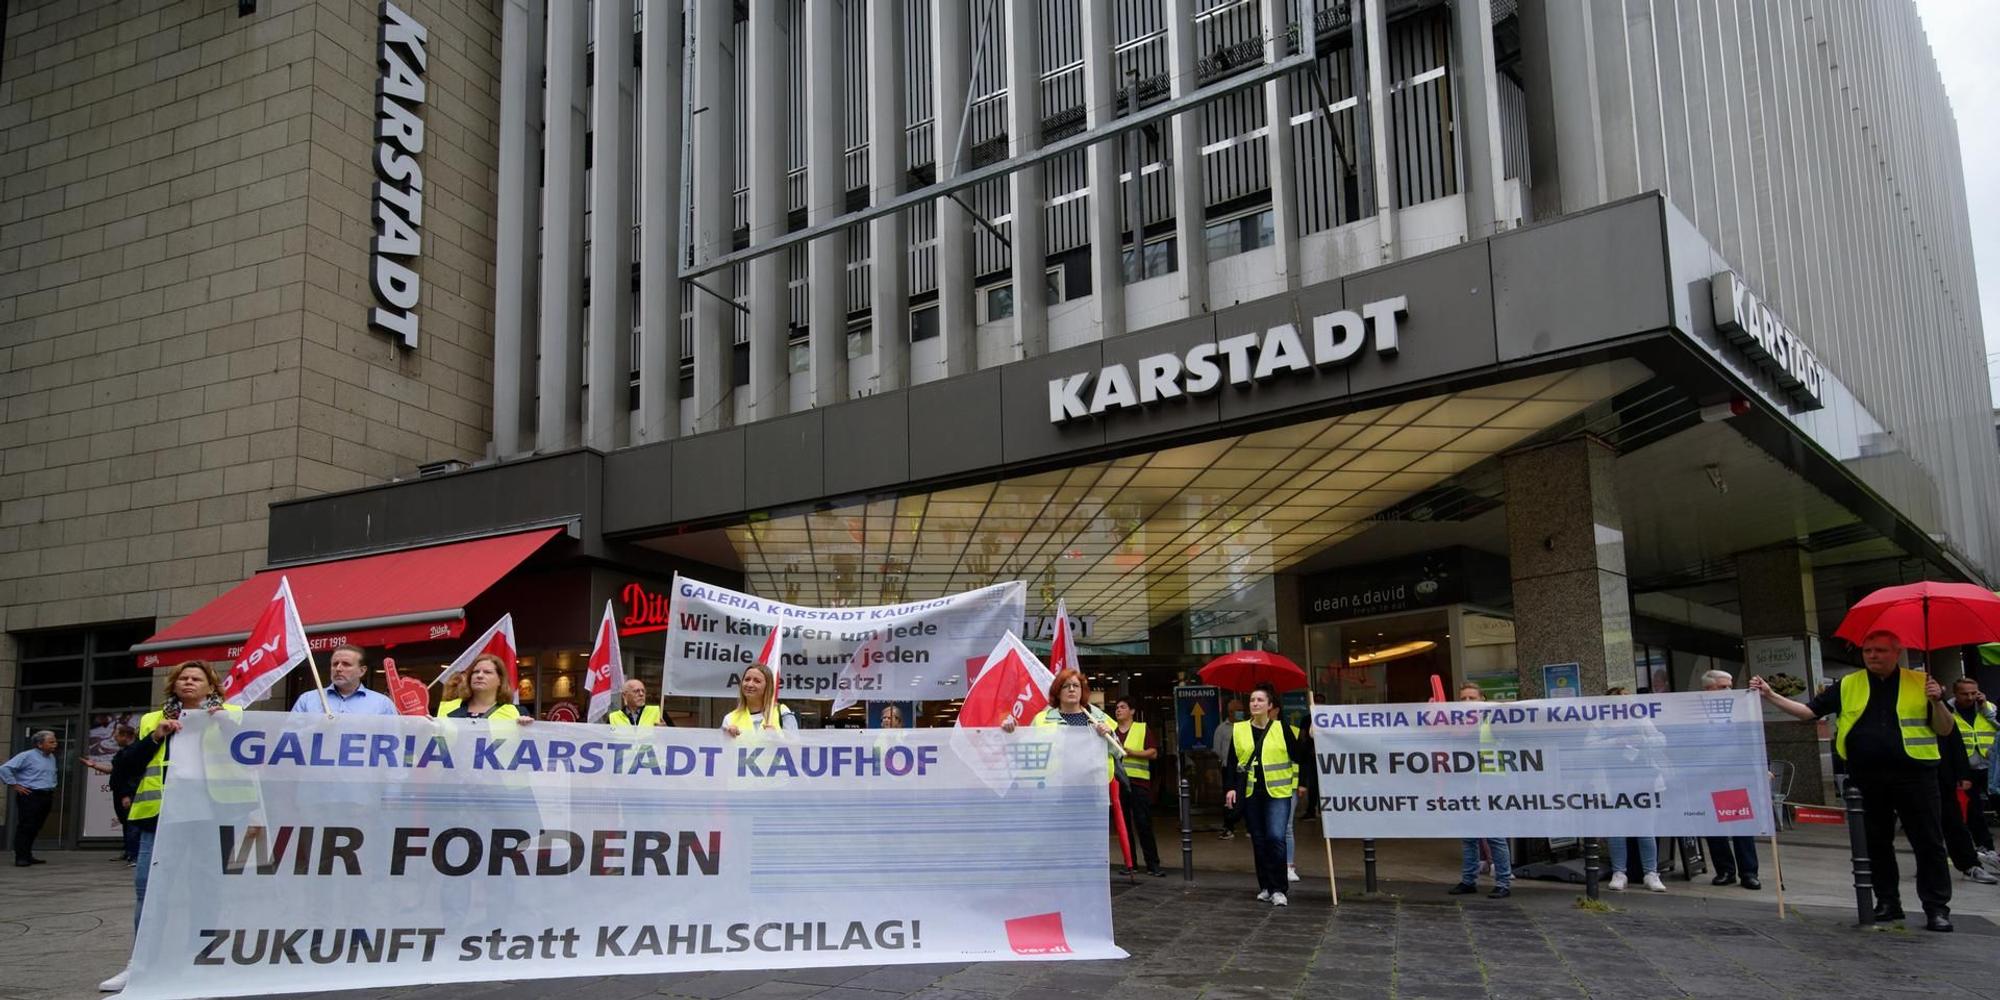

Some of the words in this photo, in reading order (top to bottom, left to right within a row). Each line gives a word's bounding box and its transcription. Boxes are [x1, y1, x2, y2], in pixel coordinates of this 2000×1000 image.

[371, 0, 428, 349] KARSTADT
[1727, 271, 1825, 408] KARSTADT
[1048, 295, 1408, 424] KARSTADT
[622, 583, 670, 627] Dits
[680, 583, 760, 611] GALERIA
[767, 605, 865, 620] KARSTADT
[870, 598, 955, 619] KAUFHOF
[1314, 597, 1348, 612] dean
[1352, 594, 1361, 607] &
[1363, 584, 1406, 605] david
[680, 613, 718, 632] Wir
[841, 629, 879, 642] um
[885, 621, 938, 643] jede
[228, 645, 244, 658] FRI
[310, 638, 327, 650] SEIT
[329, 636, 347, 648] 1919
[684, 641, 754, 664] Filiale
[781, 649, 808, 666] nd
[817, 652, 855, 664] um
[862, 646, 930, 668] jeden
[727, 672, 883, 694] Aeitsplatz!
[1178, 688, 1216, 698] EINGANG
[1313, 711, 1409, 729] GALERIA
[1417, 708, 1538, 726] KARSTADT
[1547, 702, 1662, 722] KAUFHOF
[230, 730, 454, 769] GALERIA
[473, 737, 723, 777] KARSTADT
[737, 745, 938, 778] KAUFHOF
[1317, 752, 1378, 774] WIR
[1389, 749, 1543, 774] FORDERN
[1320, 796, 1418, 812] ZUKUNFT
[1426, 795, 1481, 811] statt
[1488, 792, 1662, 810] KAHLSCHLAG!
[219, 824, 364, 876] WIR
[390, 827, 721, 877] FORDERN
[193, 928, 445, 966] ZUKUNFT
[458, 927, 580, 962] statt
[595, 919, 921, 957] KAHLSCHLAG!
